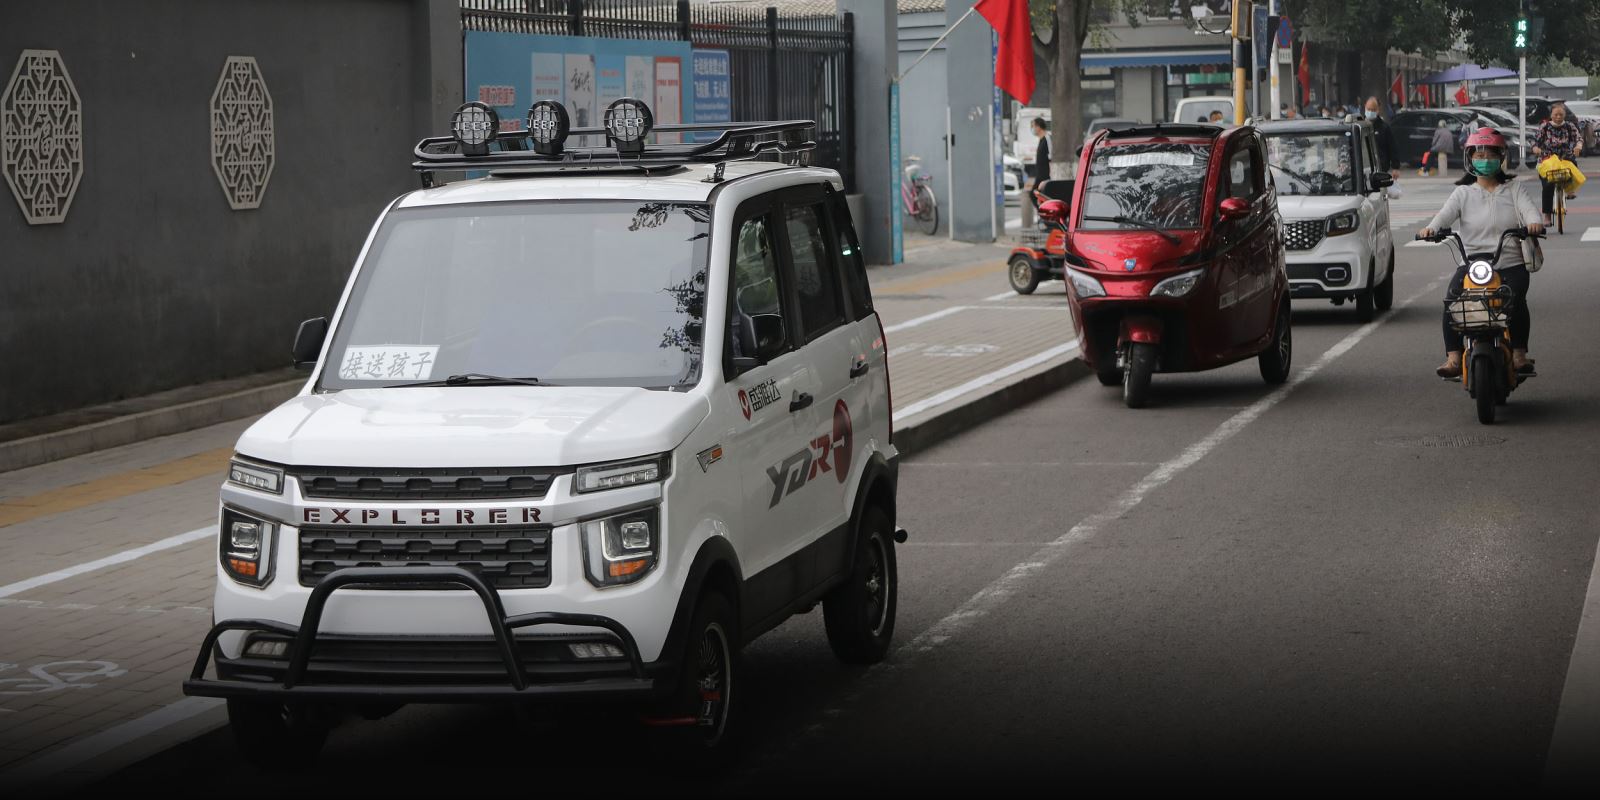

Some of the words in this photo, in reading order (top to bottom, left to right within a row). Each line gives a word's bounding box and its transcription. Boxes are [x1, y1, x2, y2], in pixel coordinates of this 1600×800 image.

[454, 121, 491, 131] JEEP
[526, 119, 555, 130] JEEP
[607, 117, 644, 129] JEEP
[342, 351, 433, 379] 接送孩子
[303, 507, 541, 525] EXPLORER
